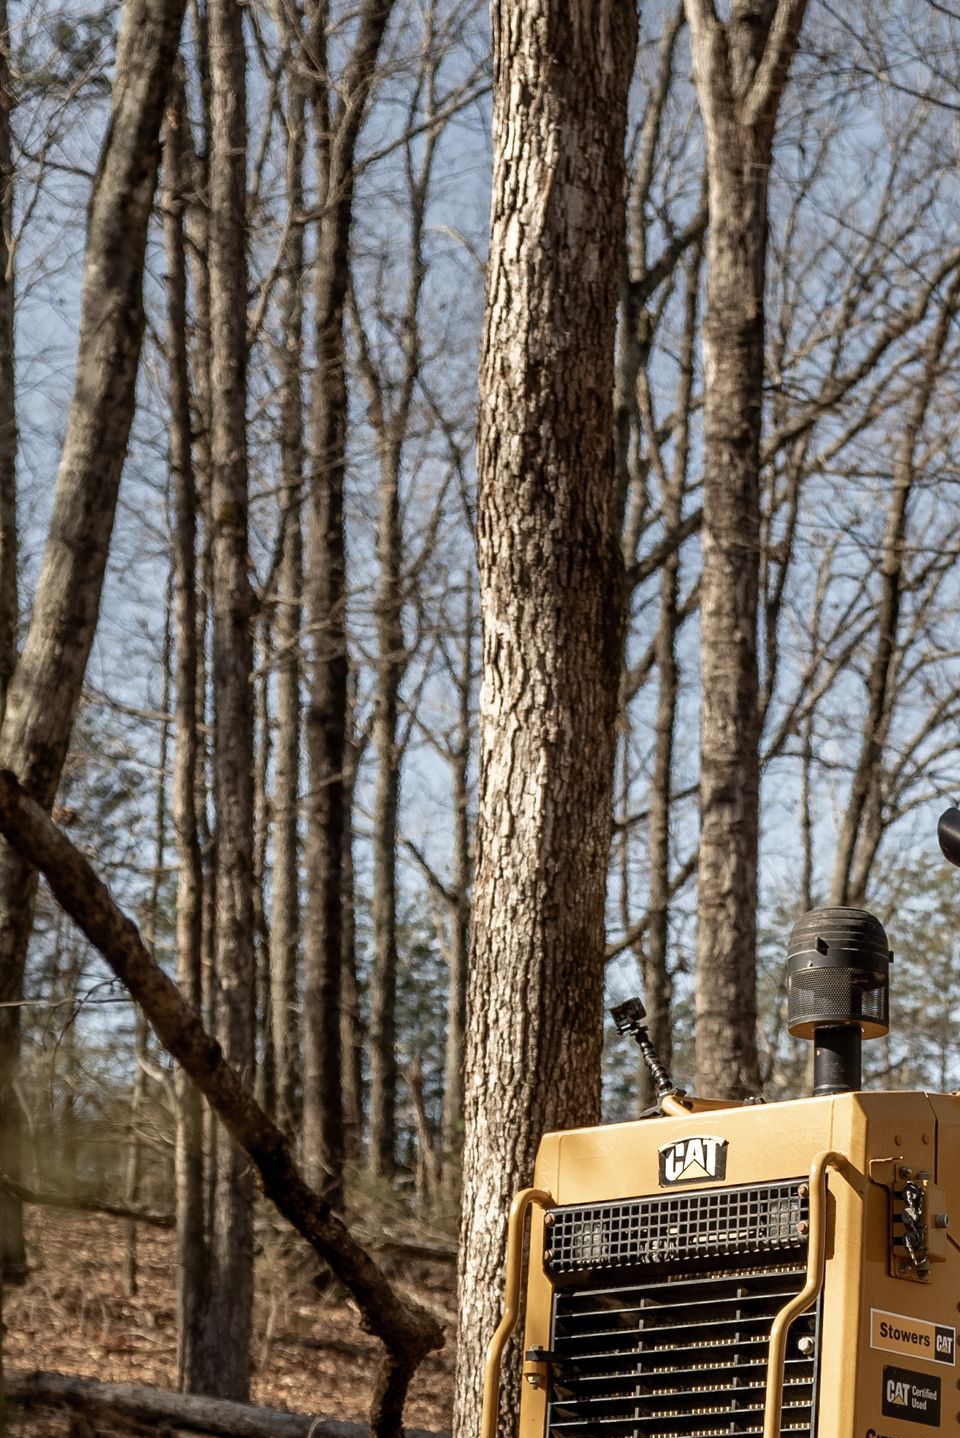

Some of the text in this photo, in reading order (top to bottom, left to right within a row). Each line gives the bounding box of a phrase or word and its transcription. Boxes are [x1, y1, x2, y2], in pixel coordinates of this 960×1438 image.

[665, 1138, 720, 1181] CAT
[879, 1321, 953, 1354] Stowers CAT
[886, 1379, 938, 1407] CAT Certified
[911, 1397, 927, 1411] Used
